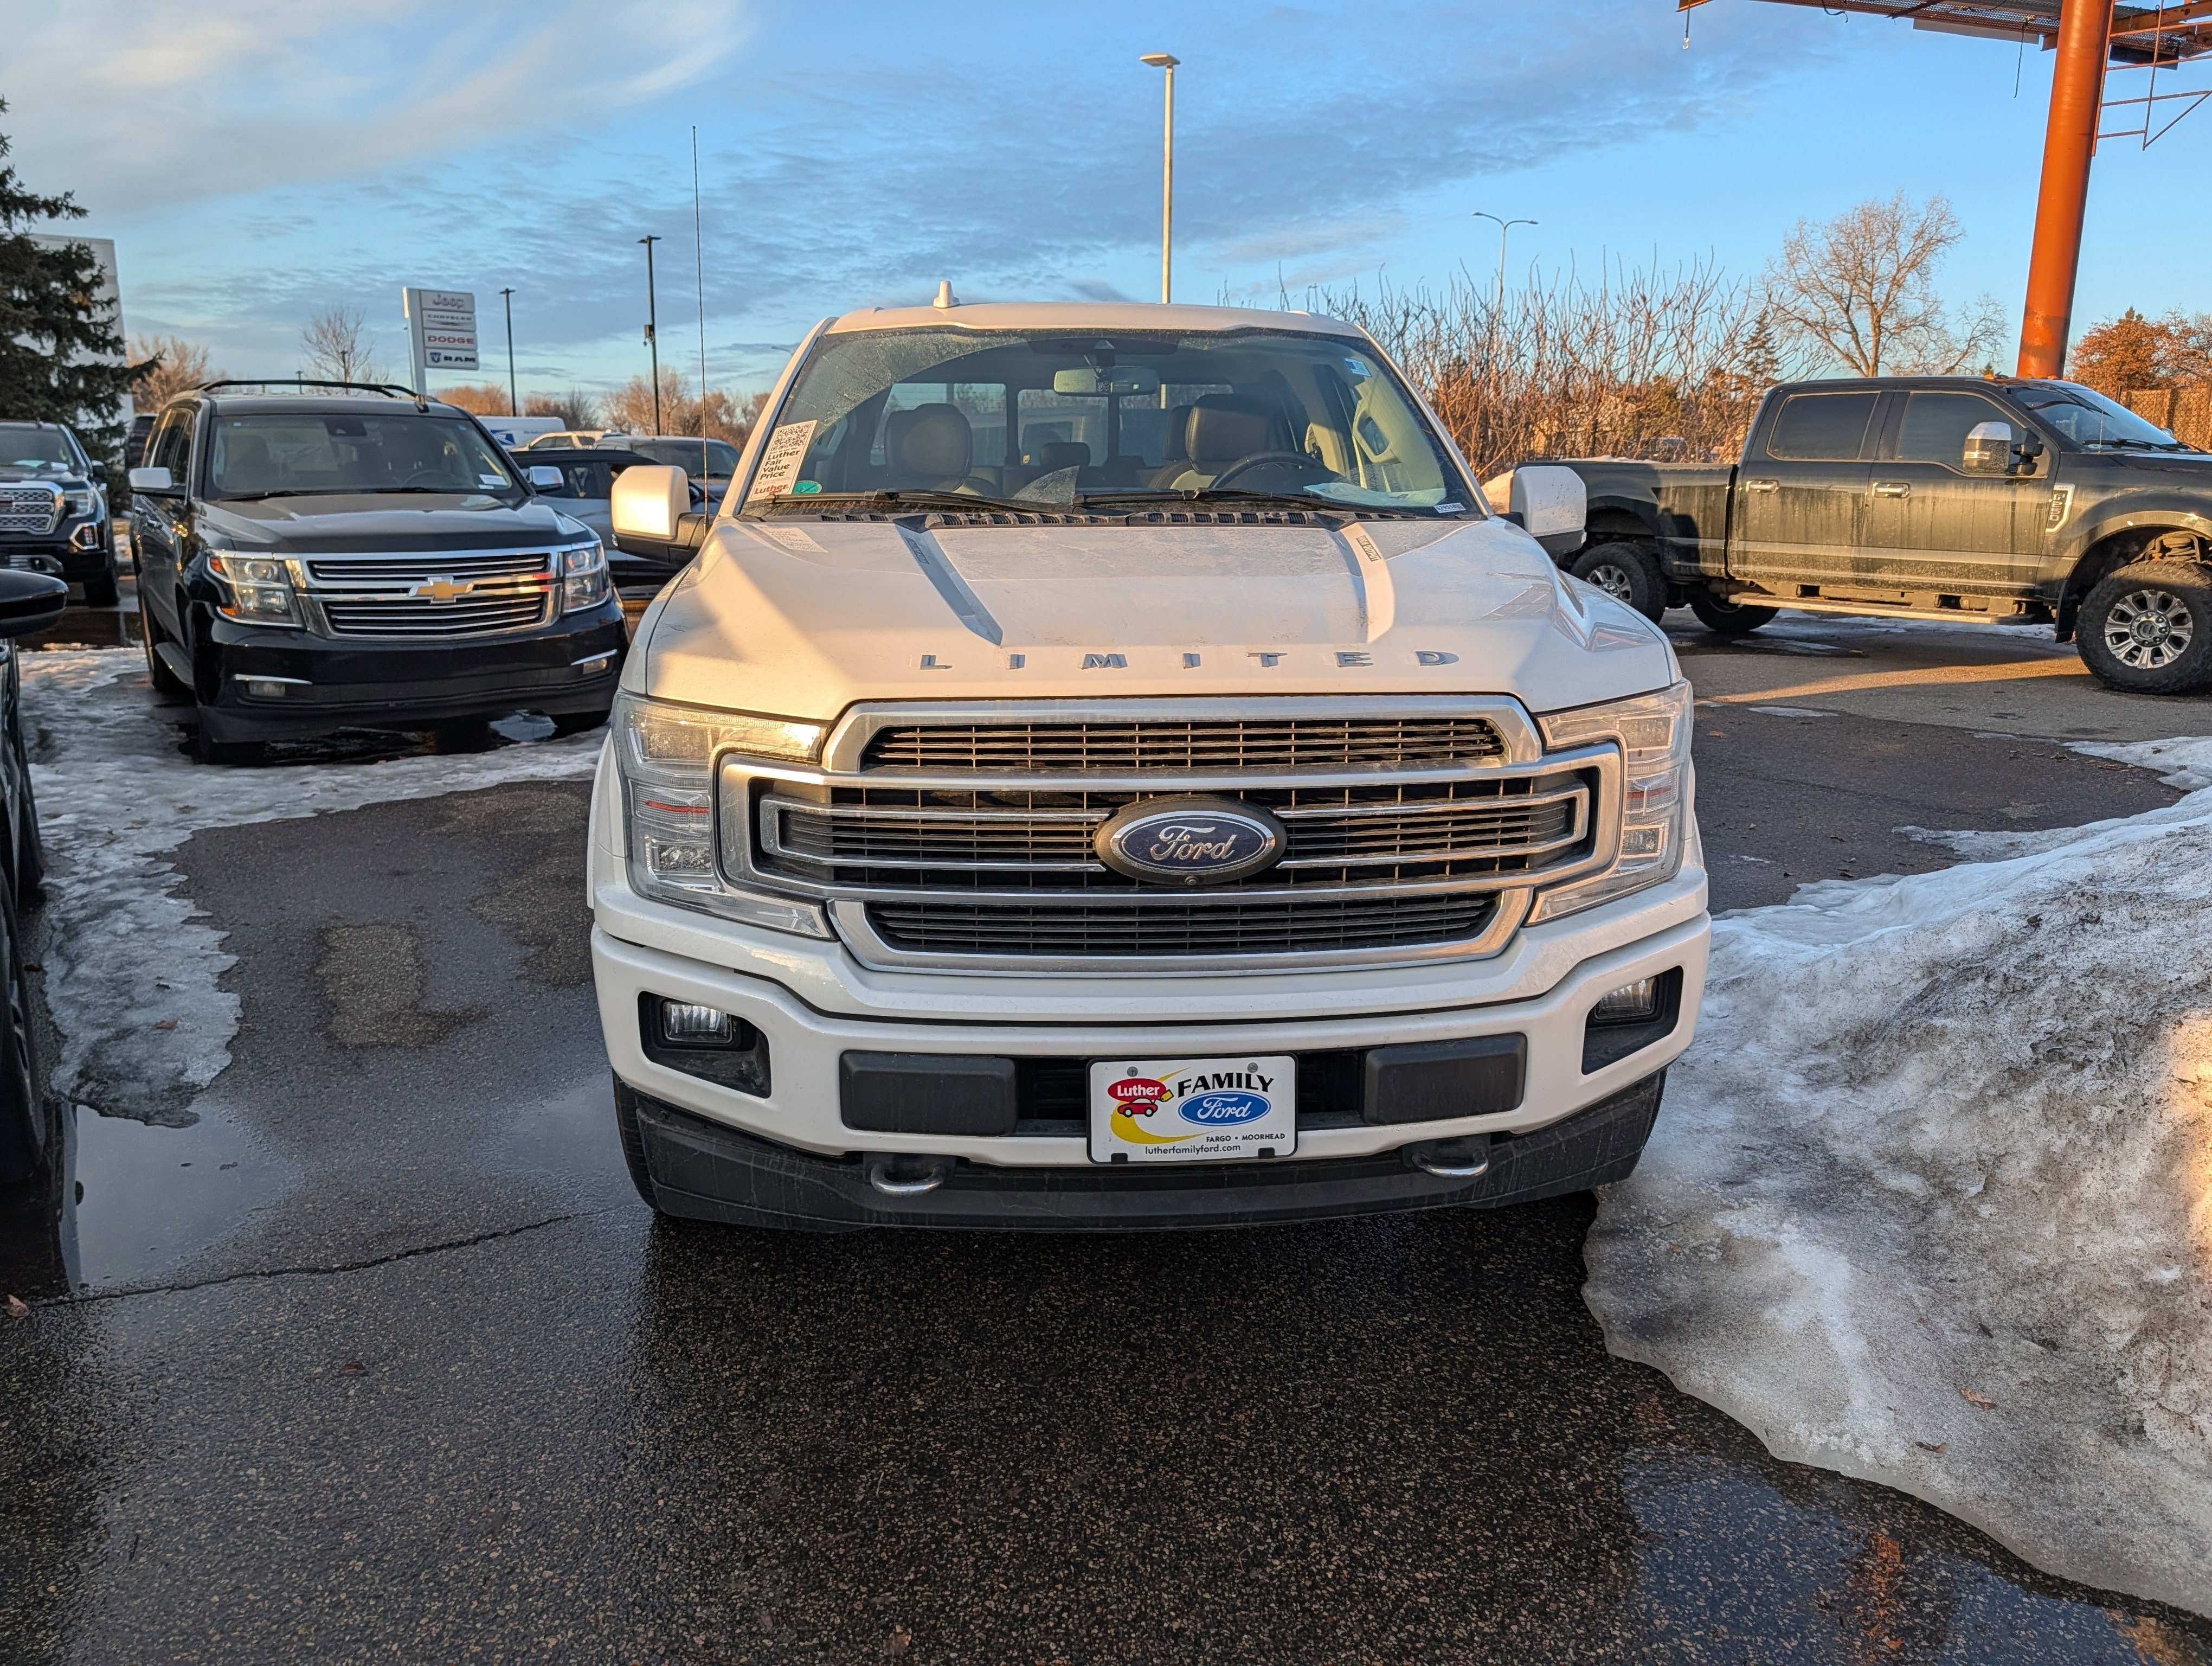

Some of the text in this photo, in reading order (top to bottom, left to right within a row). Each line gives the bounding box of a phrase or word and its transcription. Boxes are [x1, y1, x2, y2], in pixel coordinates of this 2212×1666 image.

[428, 335, 474, 344] DODGE
[767, 450, 801, 460] Luther
[764, 458, 783, 466] Fair
[763, 464, 790, 472] Value
[760, 471, 785, 480] Price
[754, 484, 788, 494] Luther
[920, 651, 1446, 670] LIMITED
[1150, 825, 1238, 860] Ford
[1117, 1084, 1160, 1097] Luther
[1178, 1072, 1275, 1098] FAMILY
[1197, 1097, 1251, 1119] Ford
[1206, 1132, 1285, 1143] FARGO MOORHEAD
[1145, 1144, 1241, 1155] lutherfamilyford.com
